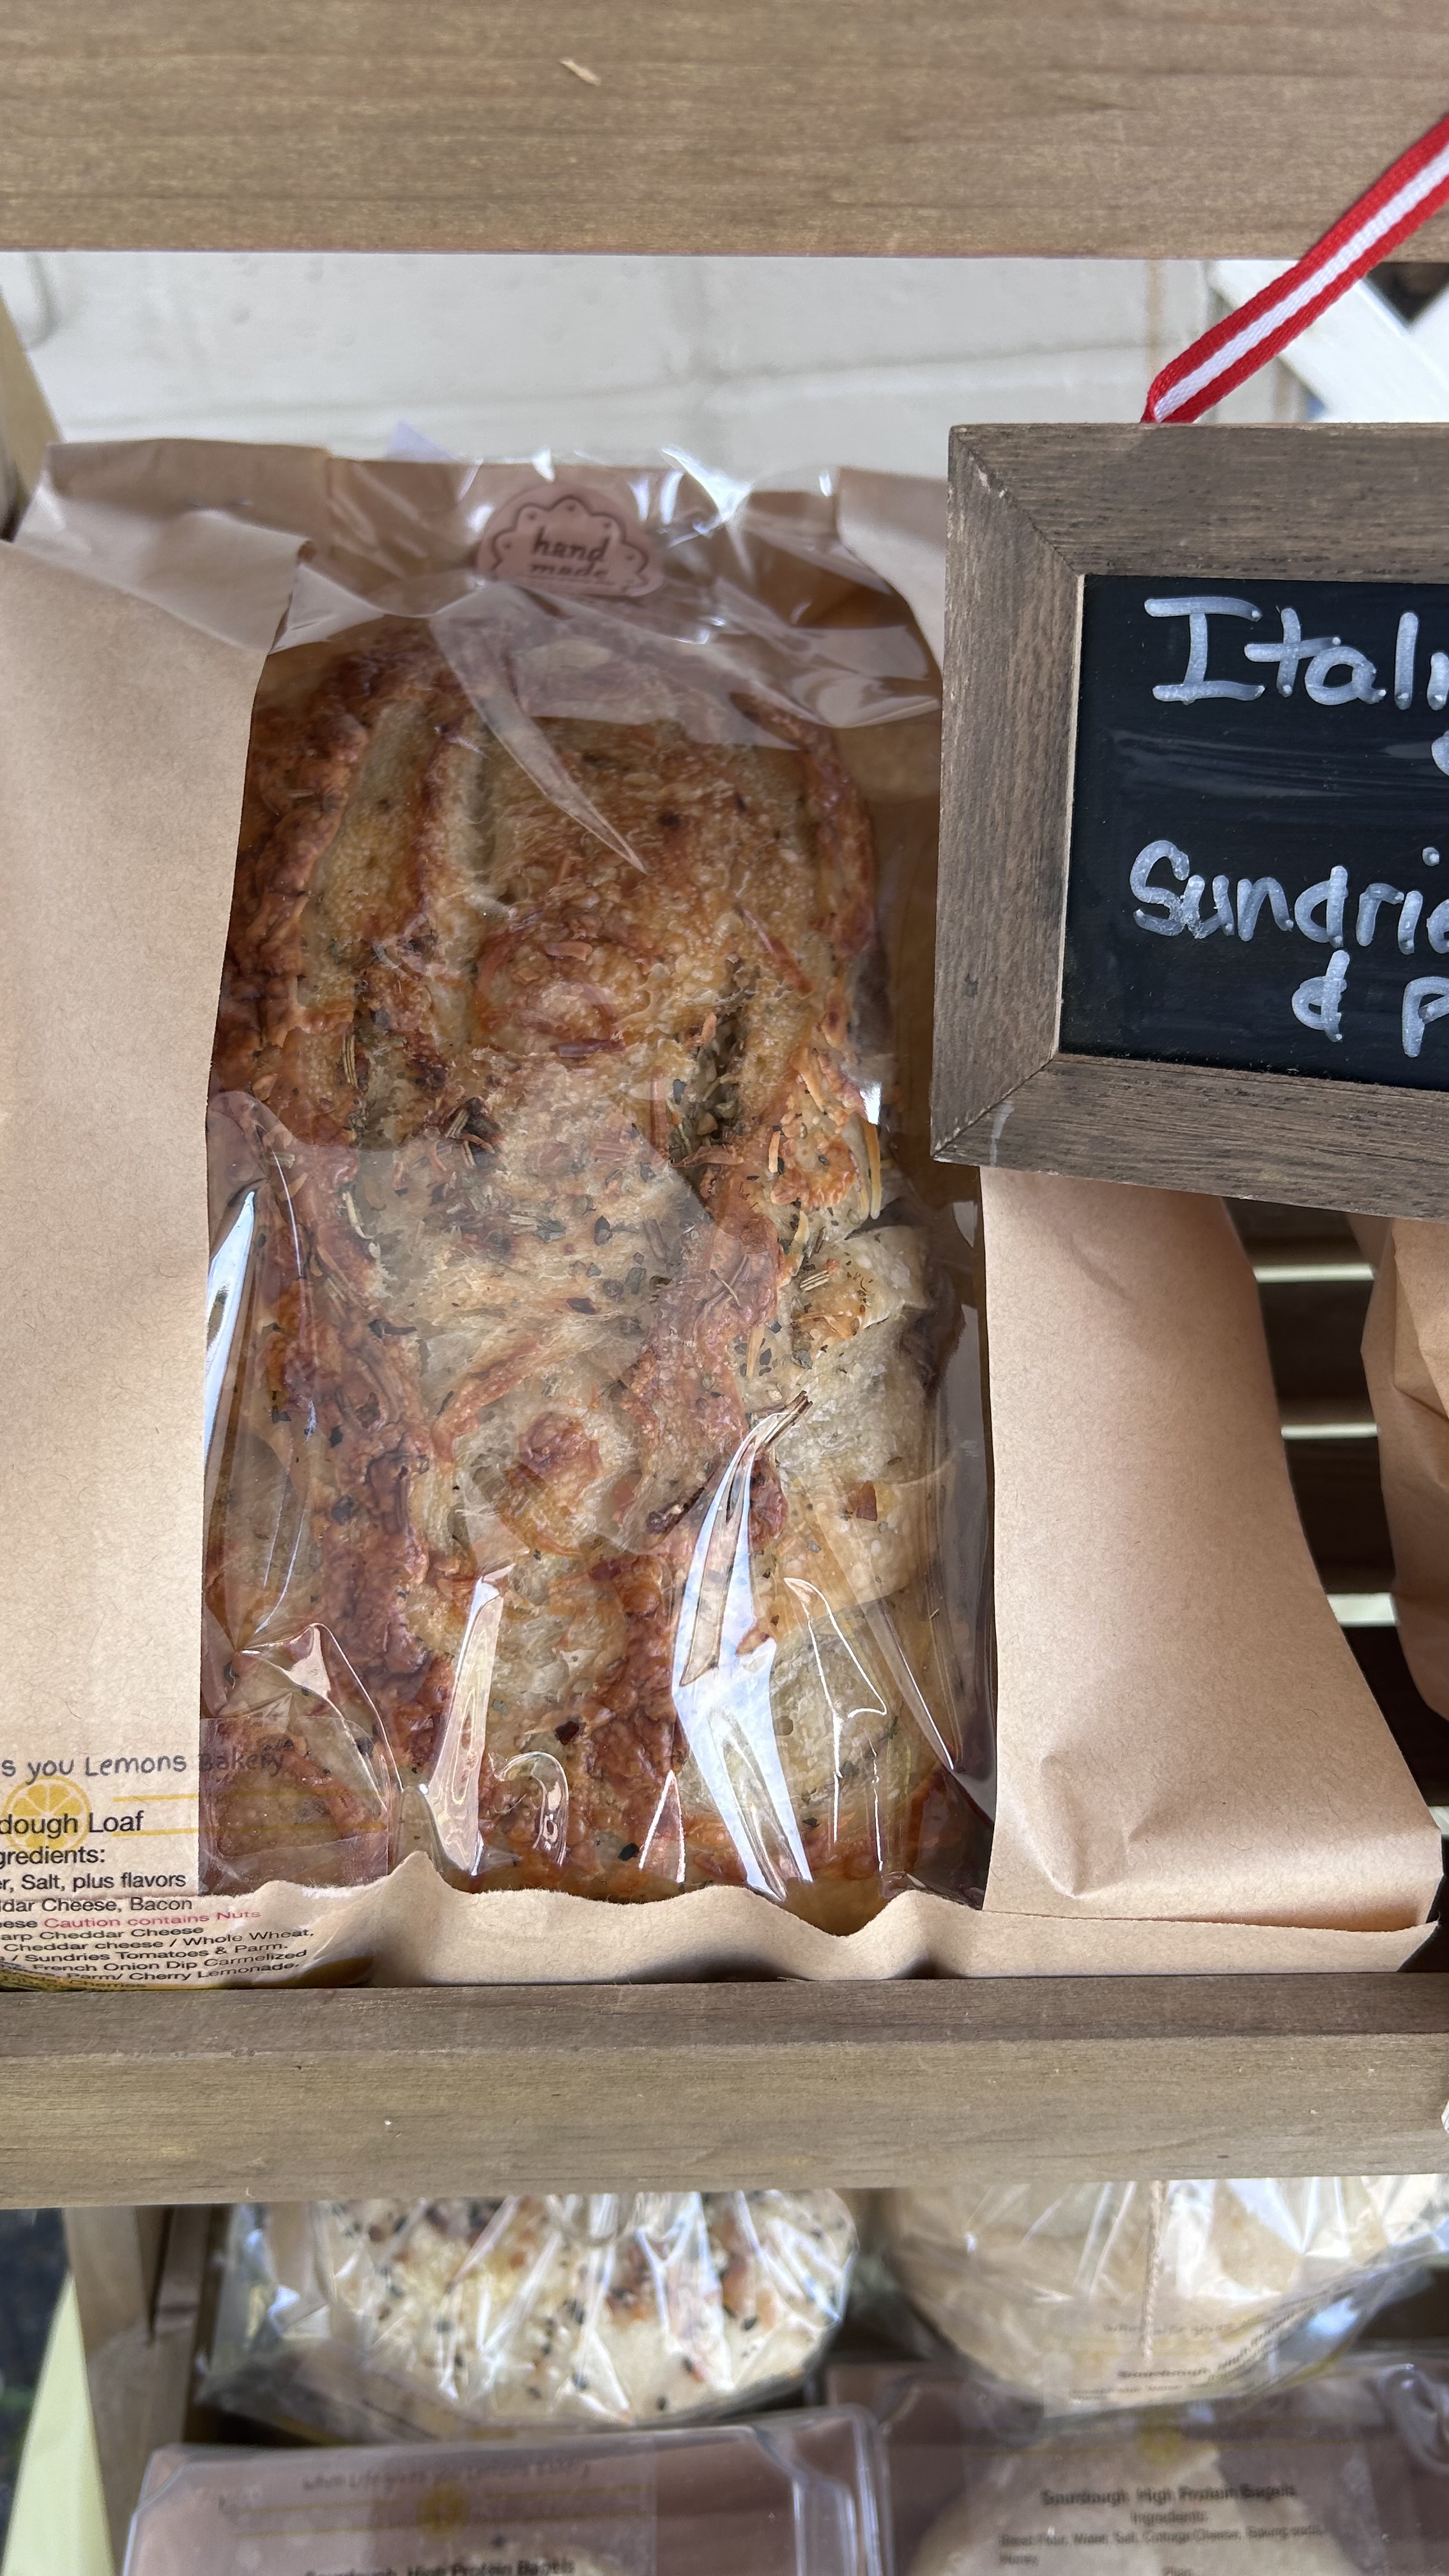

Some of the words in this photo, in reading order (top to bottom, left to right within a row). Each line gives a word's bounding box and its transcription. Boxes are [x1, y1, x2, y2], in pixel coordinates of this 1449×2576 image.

[533, 526, 610, 562] hand
[26, 1758, 75, 1786] you
[85, 1755, 187, 1777] Lemons
[0, 1813, 79, 1839] dough
[89, 1810, 145, 1833] Loaf
[0, 1878, 14, 1894] r,
[21, 1873, 65, 1892] Salt,
[73, 1873, 114, 1892] plus
[120, 1872, 187, 1889] flavors
[0, 1898, 36, 1912] dar
[42, 1897, 121, 1912] Cheese,
[130, 1896, 192, 1910] Bacon
[0, 1920, 38, 1928] ese
[44, 1917, 120, 1928] Caution
[128, 1914, 210, 1926] contains
[217, 1910, 261, 1920] Nuts
[4, 1942, 89, 1952] Cheddar
[95, 1940, 164, 1950] cheese
[169, 1938, 178, 1947] /
[183, 1934, 243, 1947] Whole
[249, 1929, 314, 1941] Wheat,
[40, 1930, 125, 1940] Cheddar
[131, 1926, 204, 1937] Cheese
[25, 1953, 111, 1962] Sundries
[116, 1950, 209, 1959] Tomatoes
[215, 1946, 227, 1955] &
[235, 1942, 288, 1954] Parm.
[103, 1962, 160, 1972] Onion
[167, 1961, 197, 1970] Dip
[204, 1949, 307, 1967] Carmelized
[129, 1972, 192, 1981] Cherry
